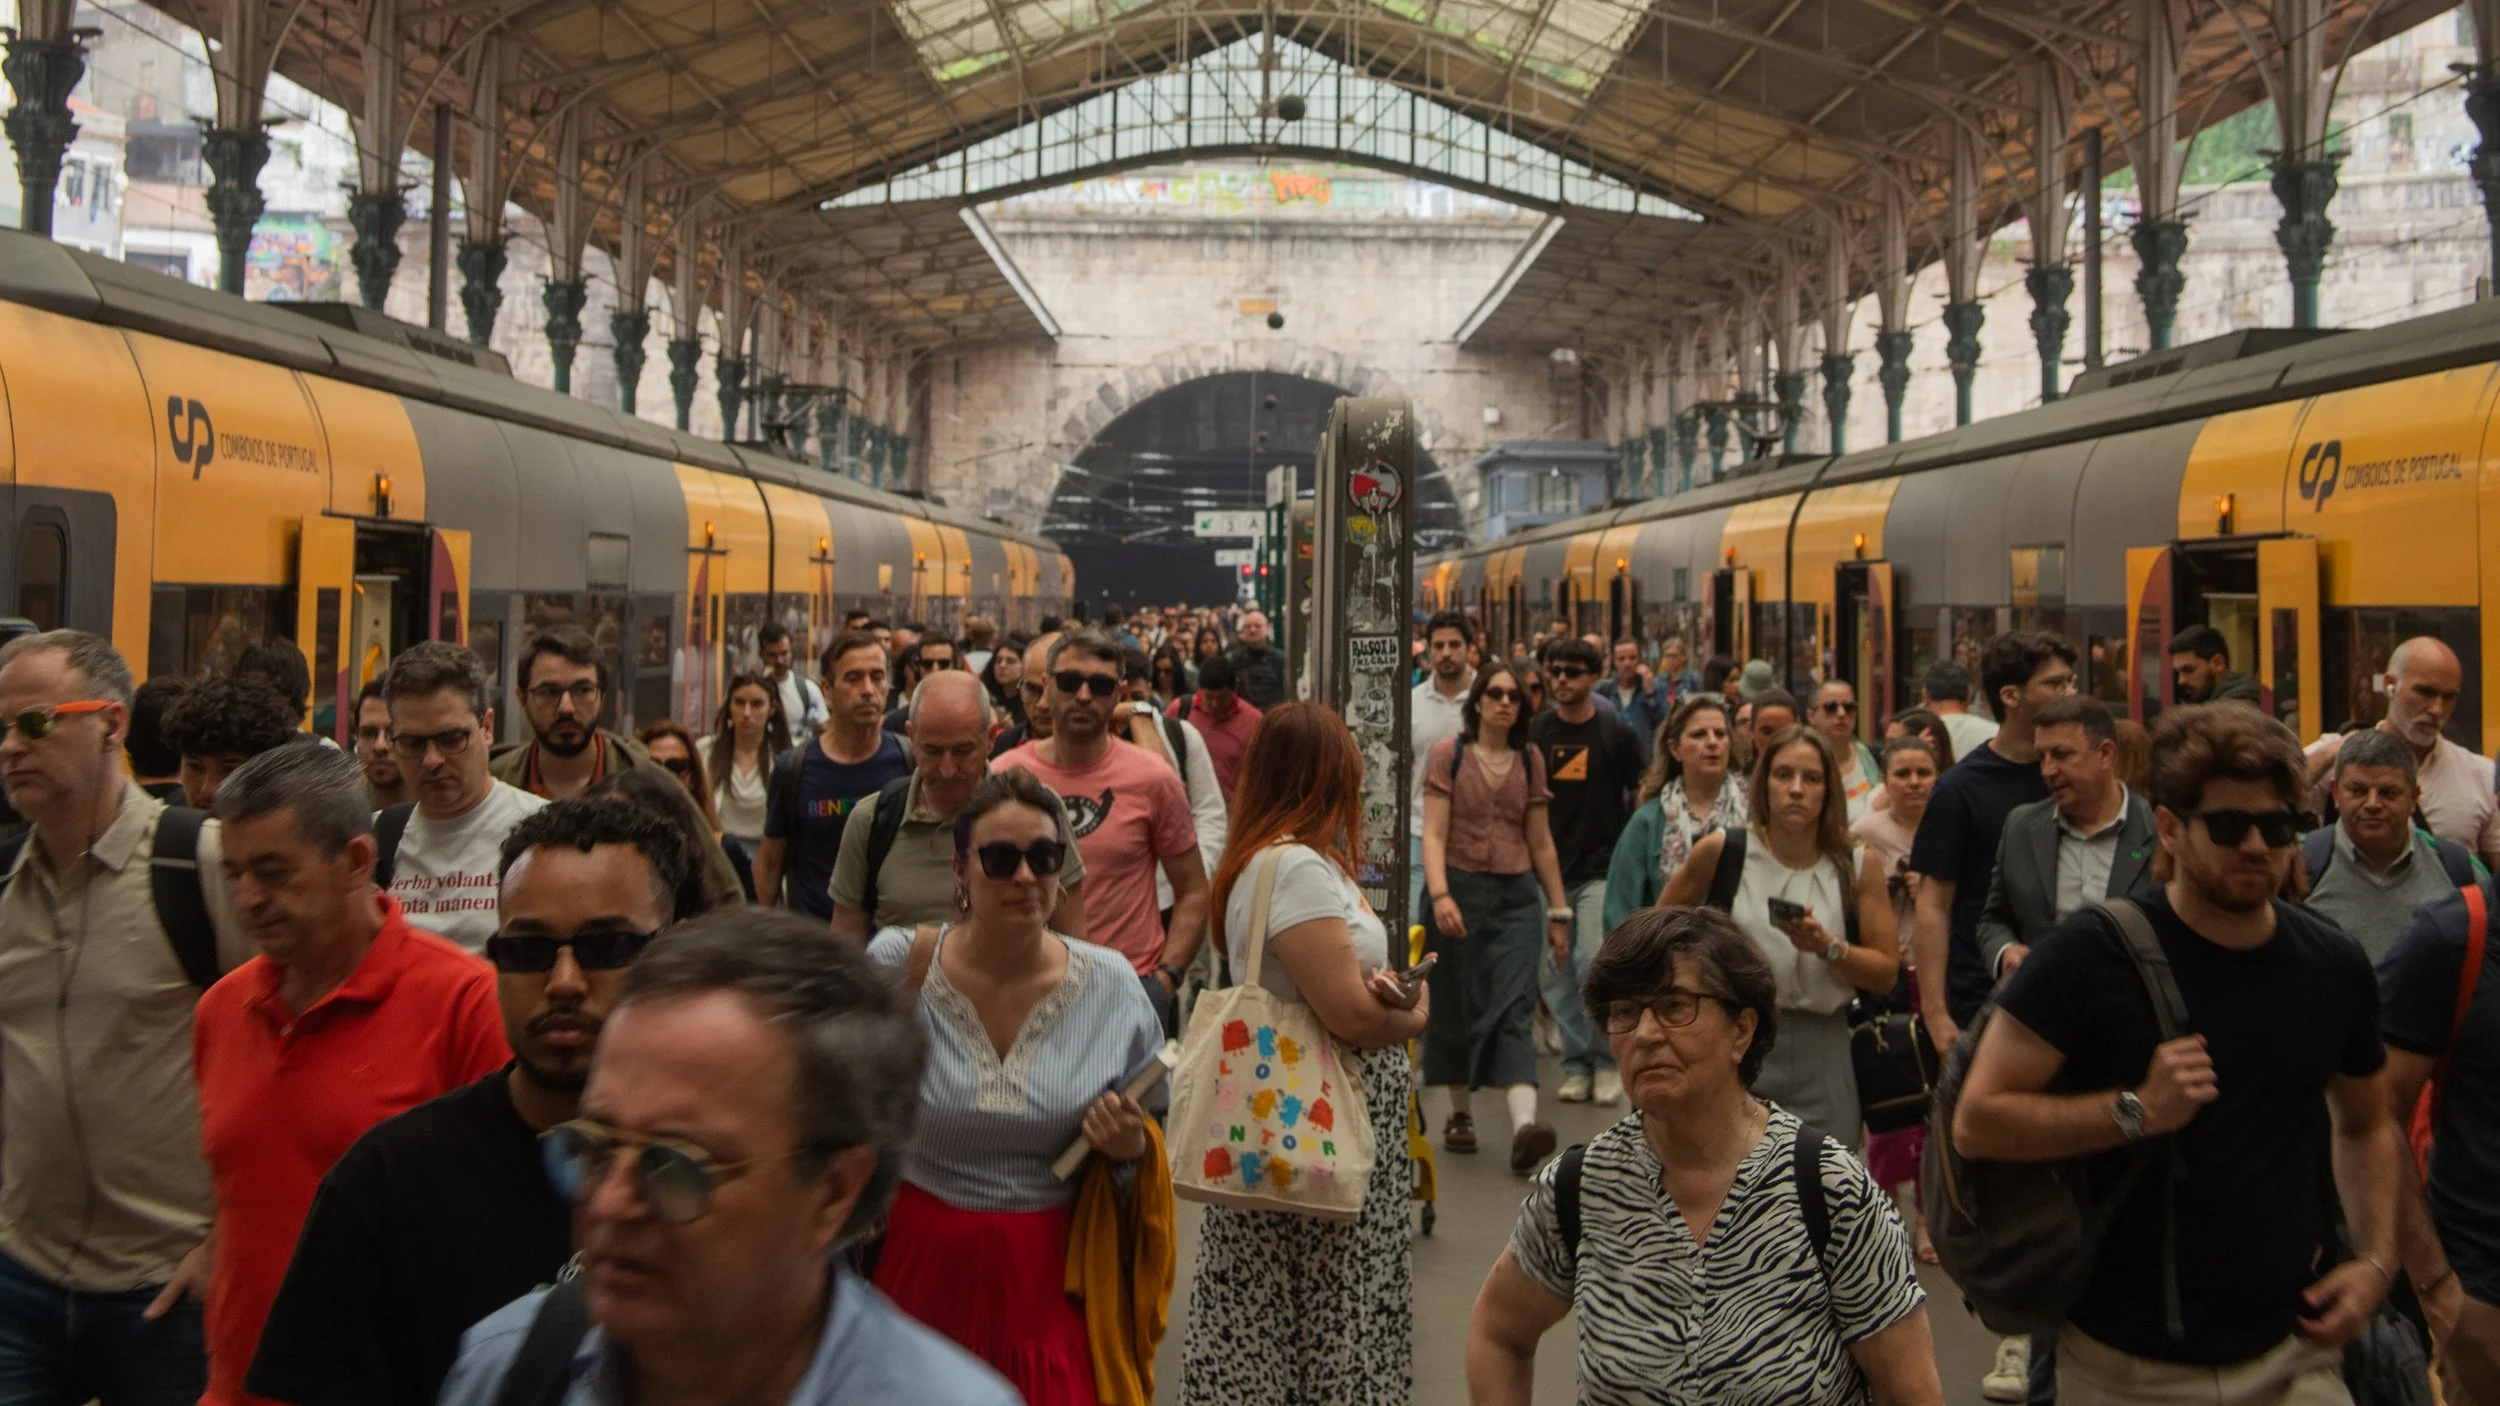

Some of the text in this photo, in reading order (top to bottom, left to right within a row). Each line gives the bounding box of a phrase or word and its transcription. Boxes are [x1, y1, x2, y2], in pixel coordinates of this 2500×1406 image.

[220, 432, 319, 474] COMBOIOS DE PORTUGAL
[2344, 452, 2462, 489] COMBOIOS DE PORTUGAL
[808, 798, 857, 817] BENE
